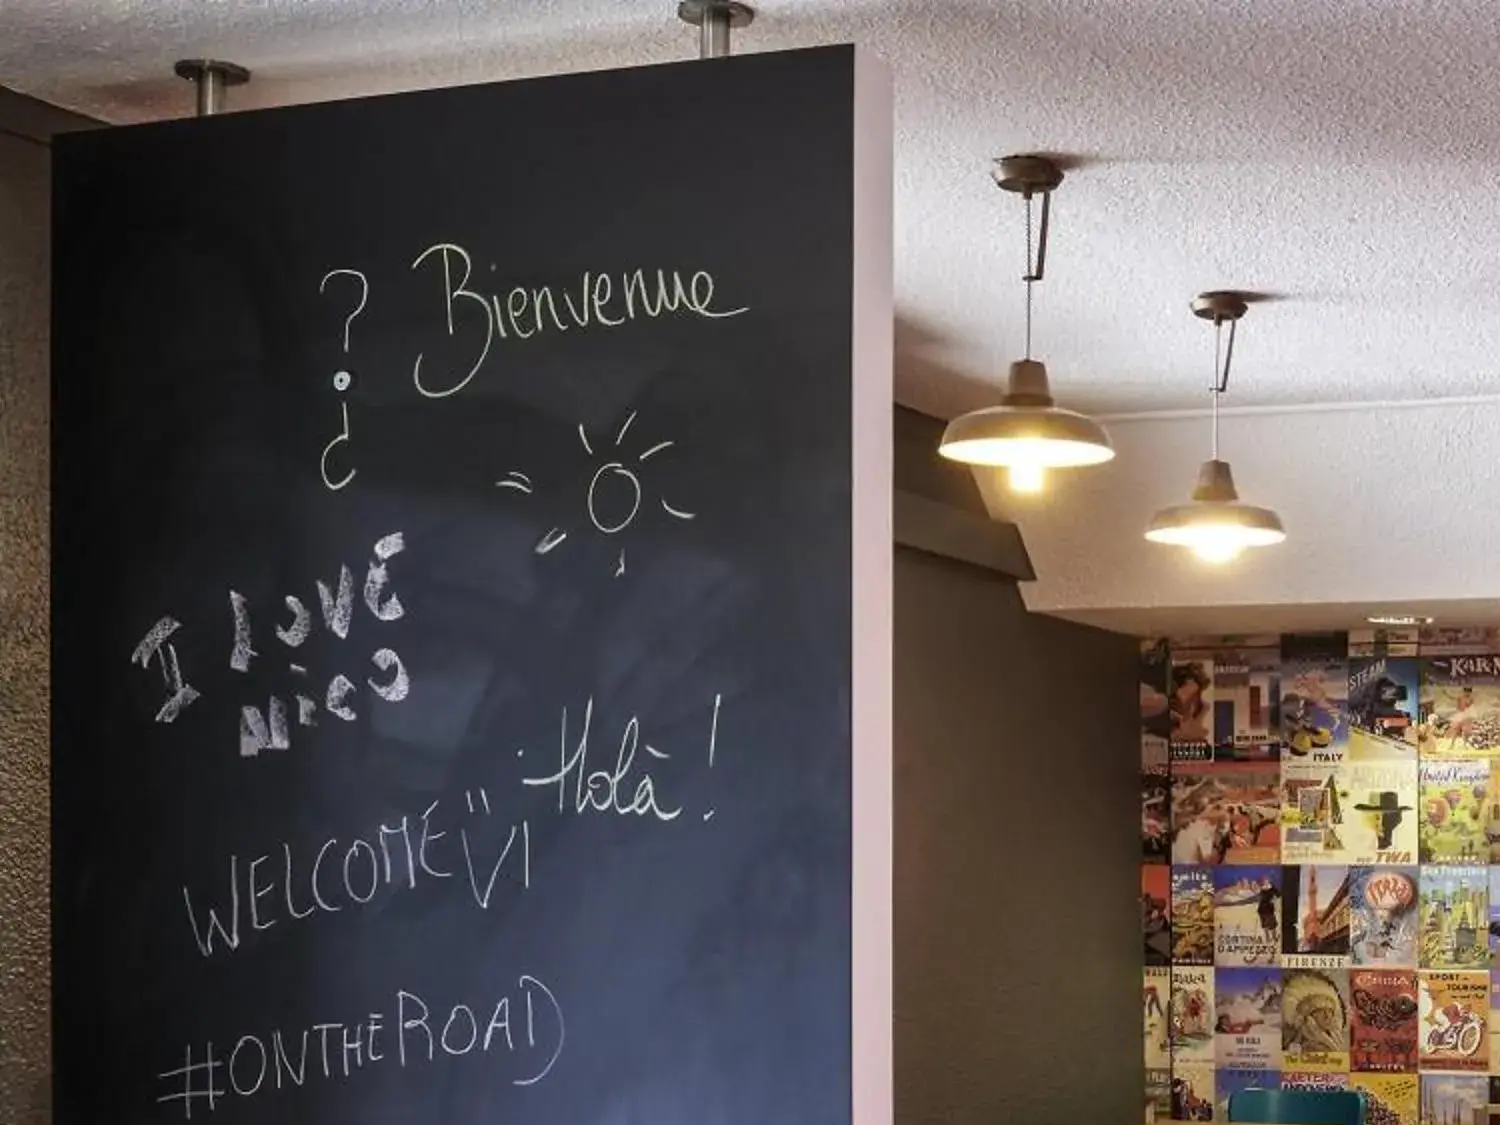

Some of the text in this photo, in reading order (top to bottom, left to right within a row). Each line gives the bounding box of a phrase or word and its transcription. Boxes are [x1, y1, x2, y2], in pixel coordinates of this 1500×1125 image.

[412, 243, 750, 398] Bienvenue
[131, 616, 200, 723] I
[1313, 752, 1343, 762] ITALY
[183, 800, 452, 956] WELCOME
[1287, 957, 1345, 968] FIRENZE
